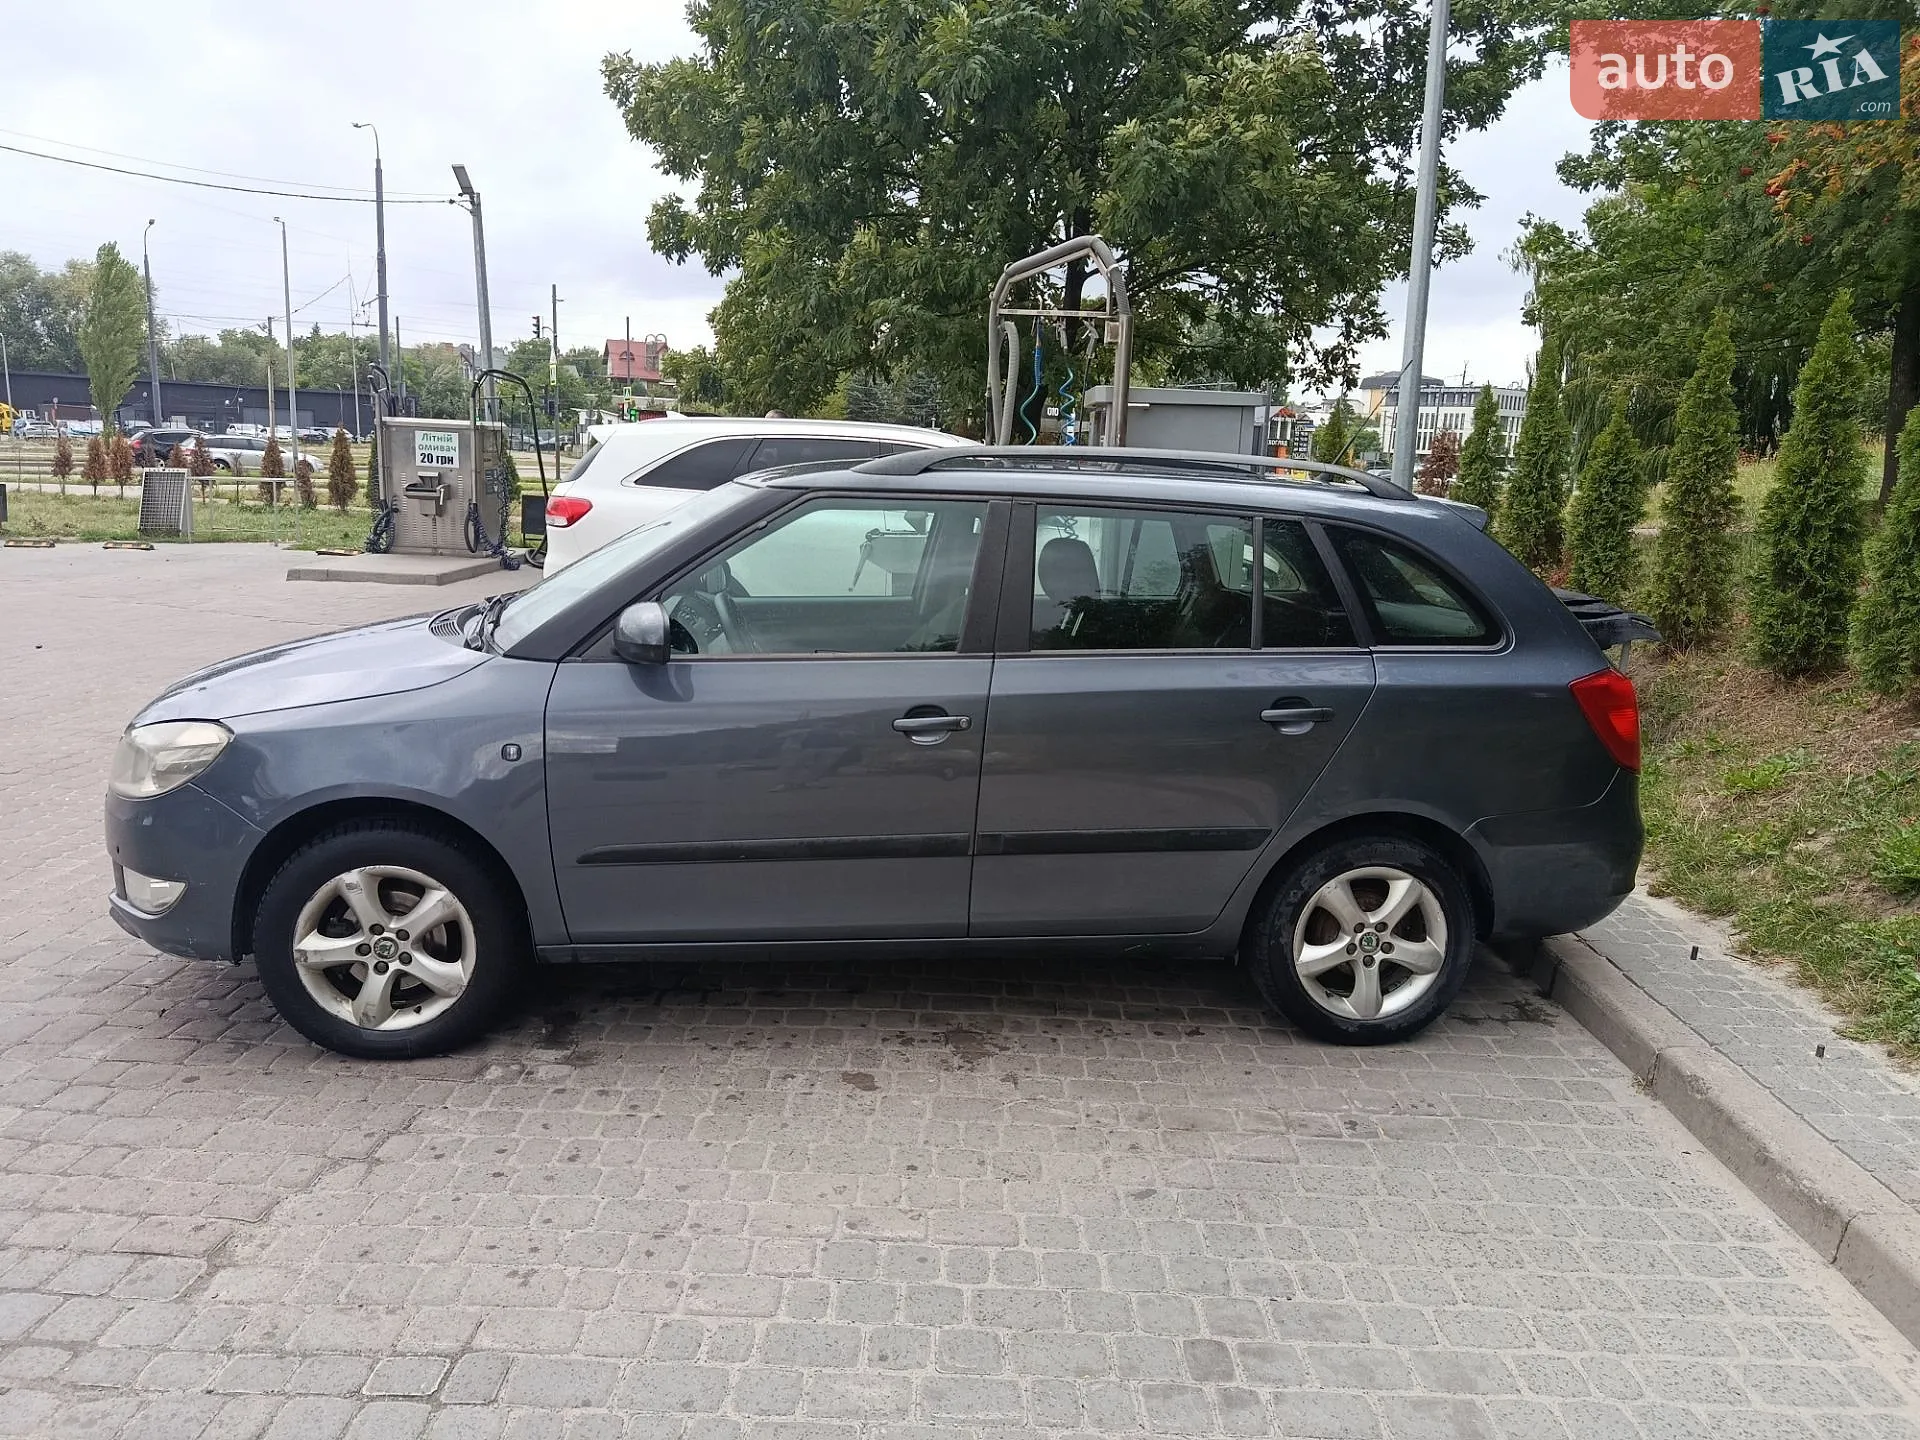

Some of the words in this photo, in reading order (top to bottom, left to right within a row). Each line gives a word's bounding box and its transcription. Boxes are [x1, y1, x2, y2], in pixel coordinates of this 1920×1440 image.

[421, 433, 453, 443] Літній
[418, 444, 457, 452] омивач
[420, 452, 434, 464] 20
[436, 455, 454, 465] грн
